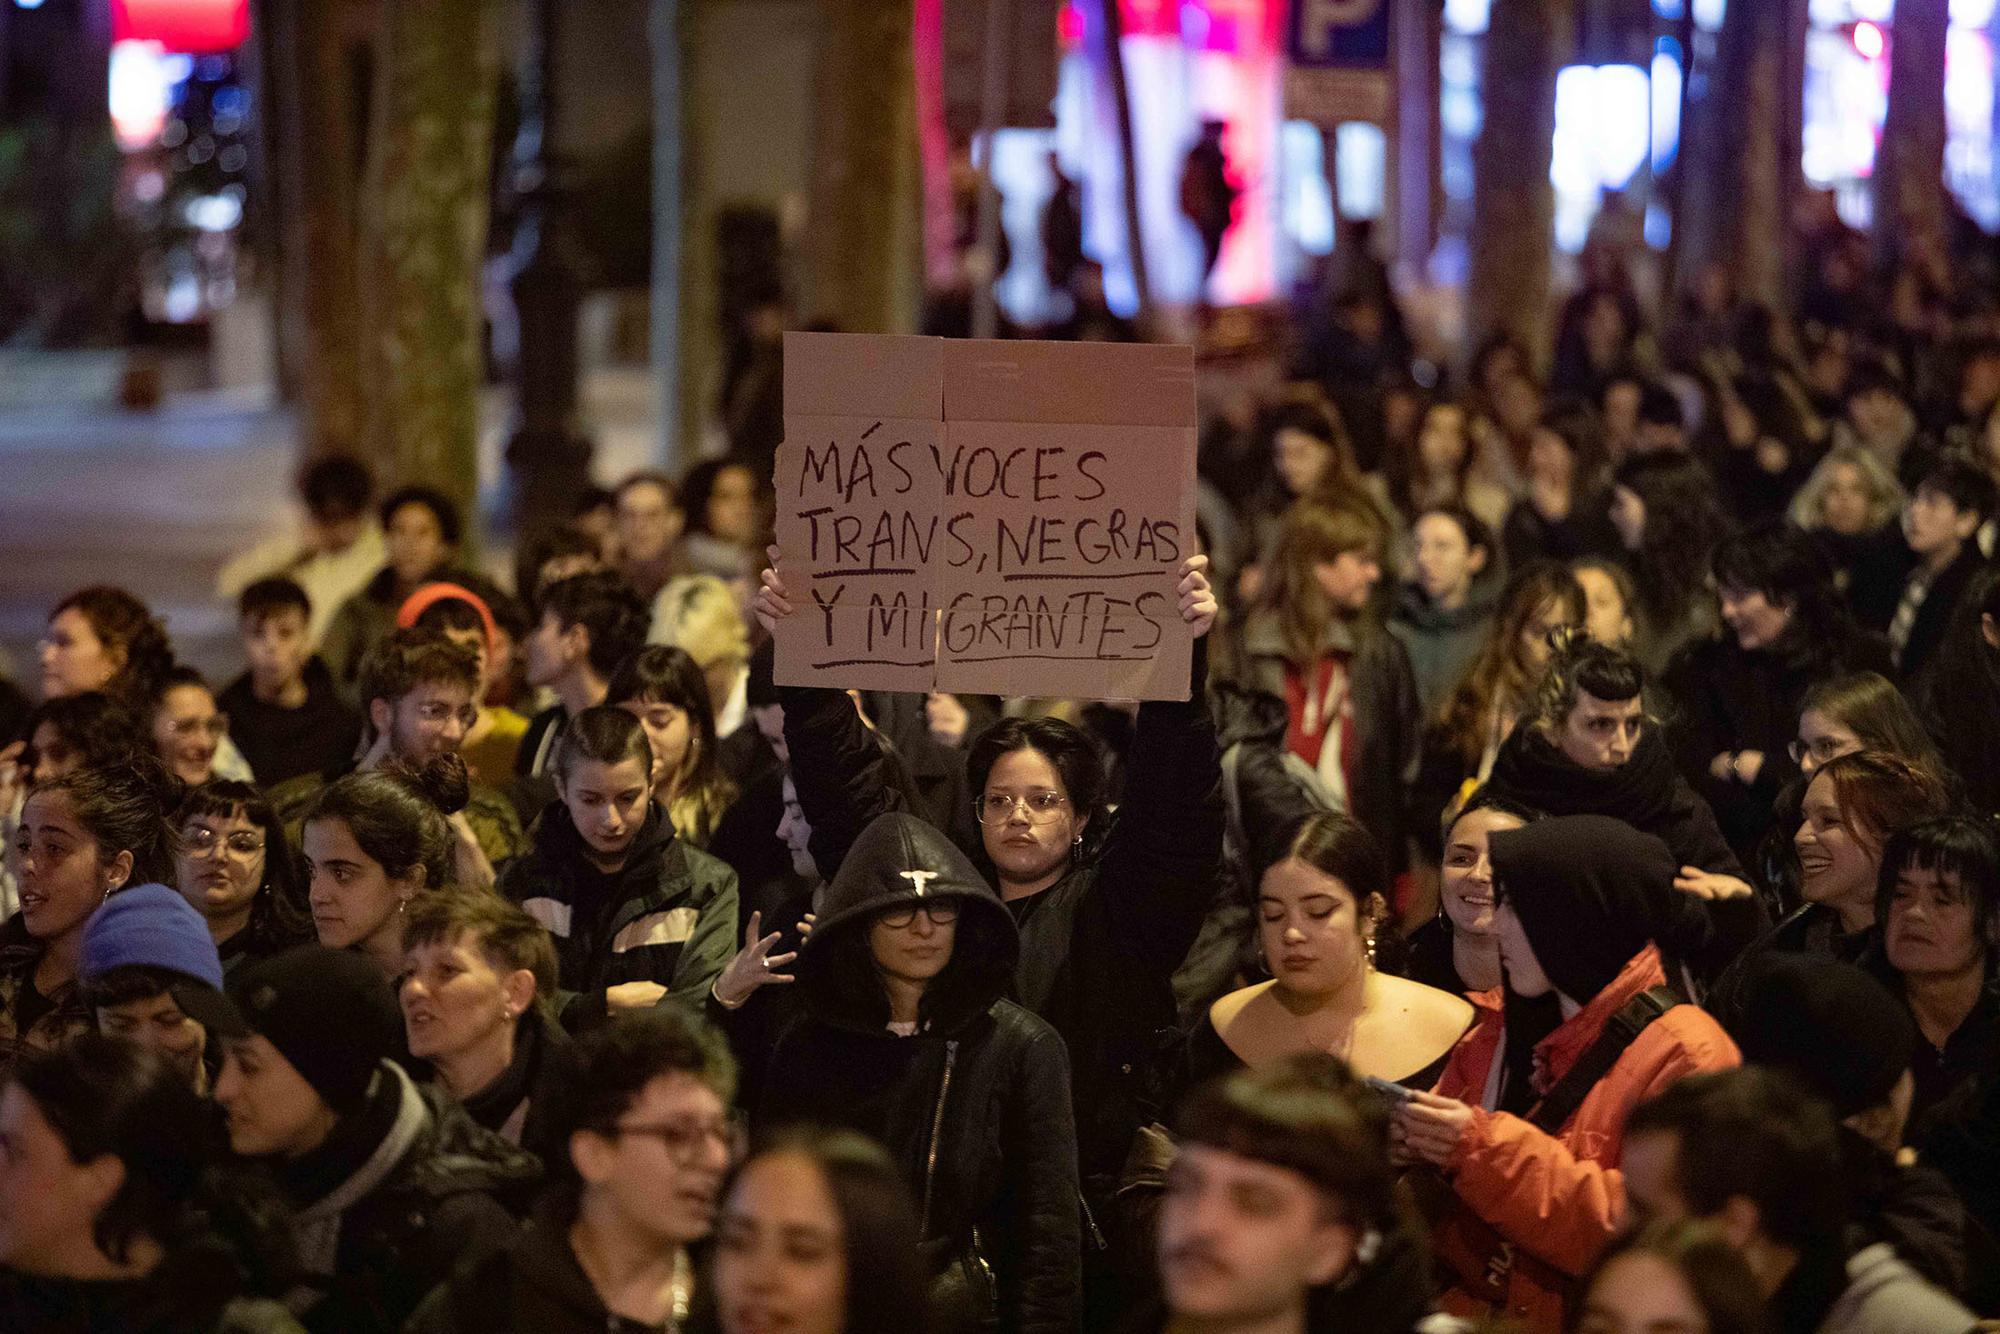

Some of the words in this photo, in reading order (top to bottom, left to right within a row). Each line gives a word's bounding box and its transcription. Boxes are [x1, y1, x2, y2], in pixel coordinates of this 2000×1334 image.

[1301, 0, 1378, 55] P
[800, 422, 912, 503] MÁS
[930, 444, 1107, 502] VOCES
[798, 507, 988, 574] TRANS,
[998, 508, 1180, 572] NEGRAS
[811, 584, 846, 646] Y
[867, 591, 1167, 657] MIGRANTES
